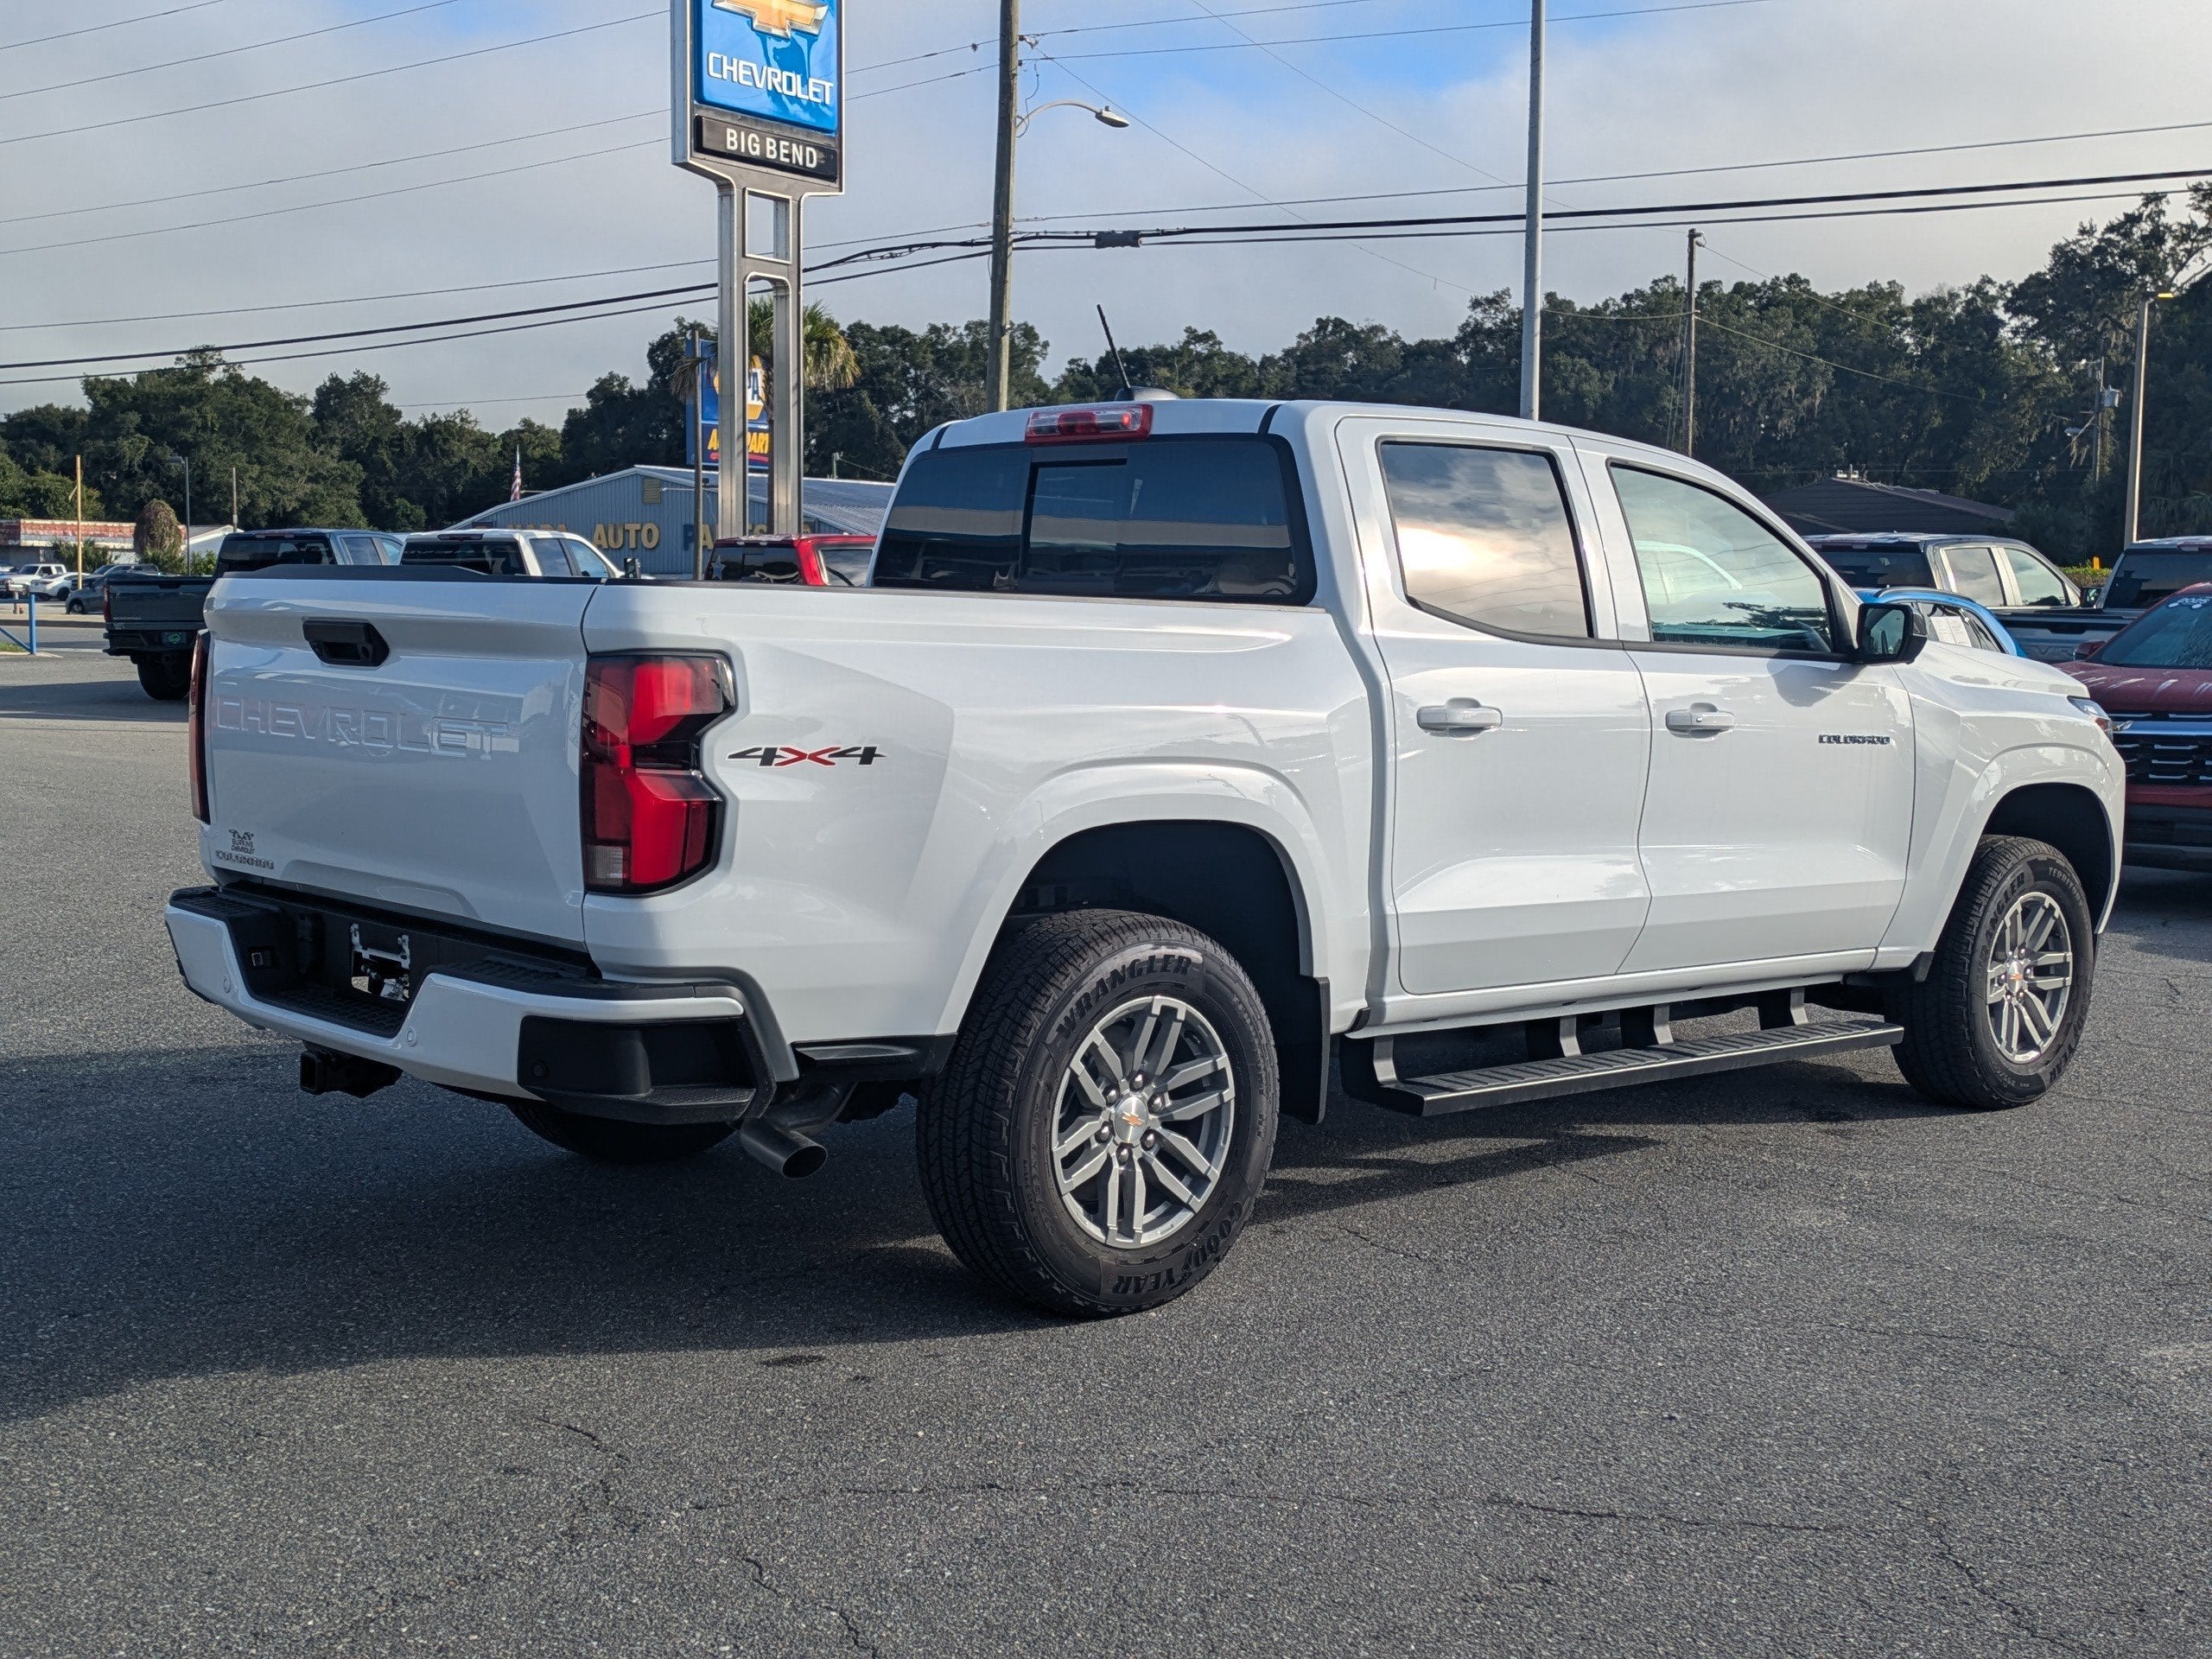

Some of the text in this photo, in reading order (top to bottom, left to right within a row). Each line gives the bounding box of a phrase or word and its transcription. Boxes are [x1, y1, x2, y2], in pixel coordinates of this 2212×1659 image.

[708, 51, 834, 105] CHEVROLET
[726, 127, 817, 168] BIG BEND
[591, 523, 660, 550] AUTO
[216, 698, 508, 760] CHEVROLET
[1818, 734, 1891, 745] COLORADO
[1055, 954, 1192, 1040] WRANGLER
